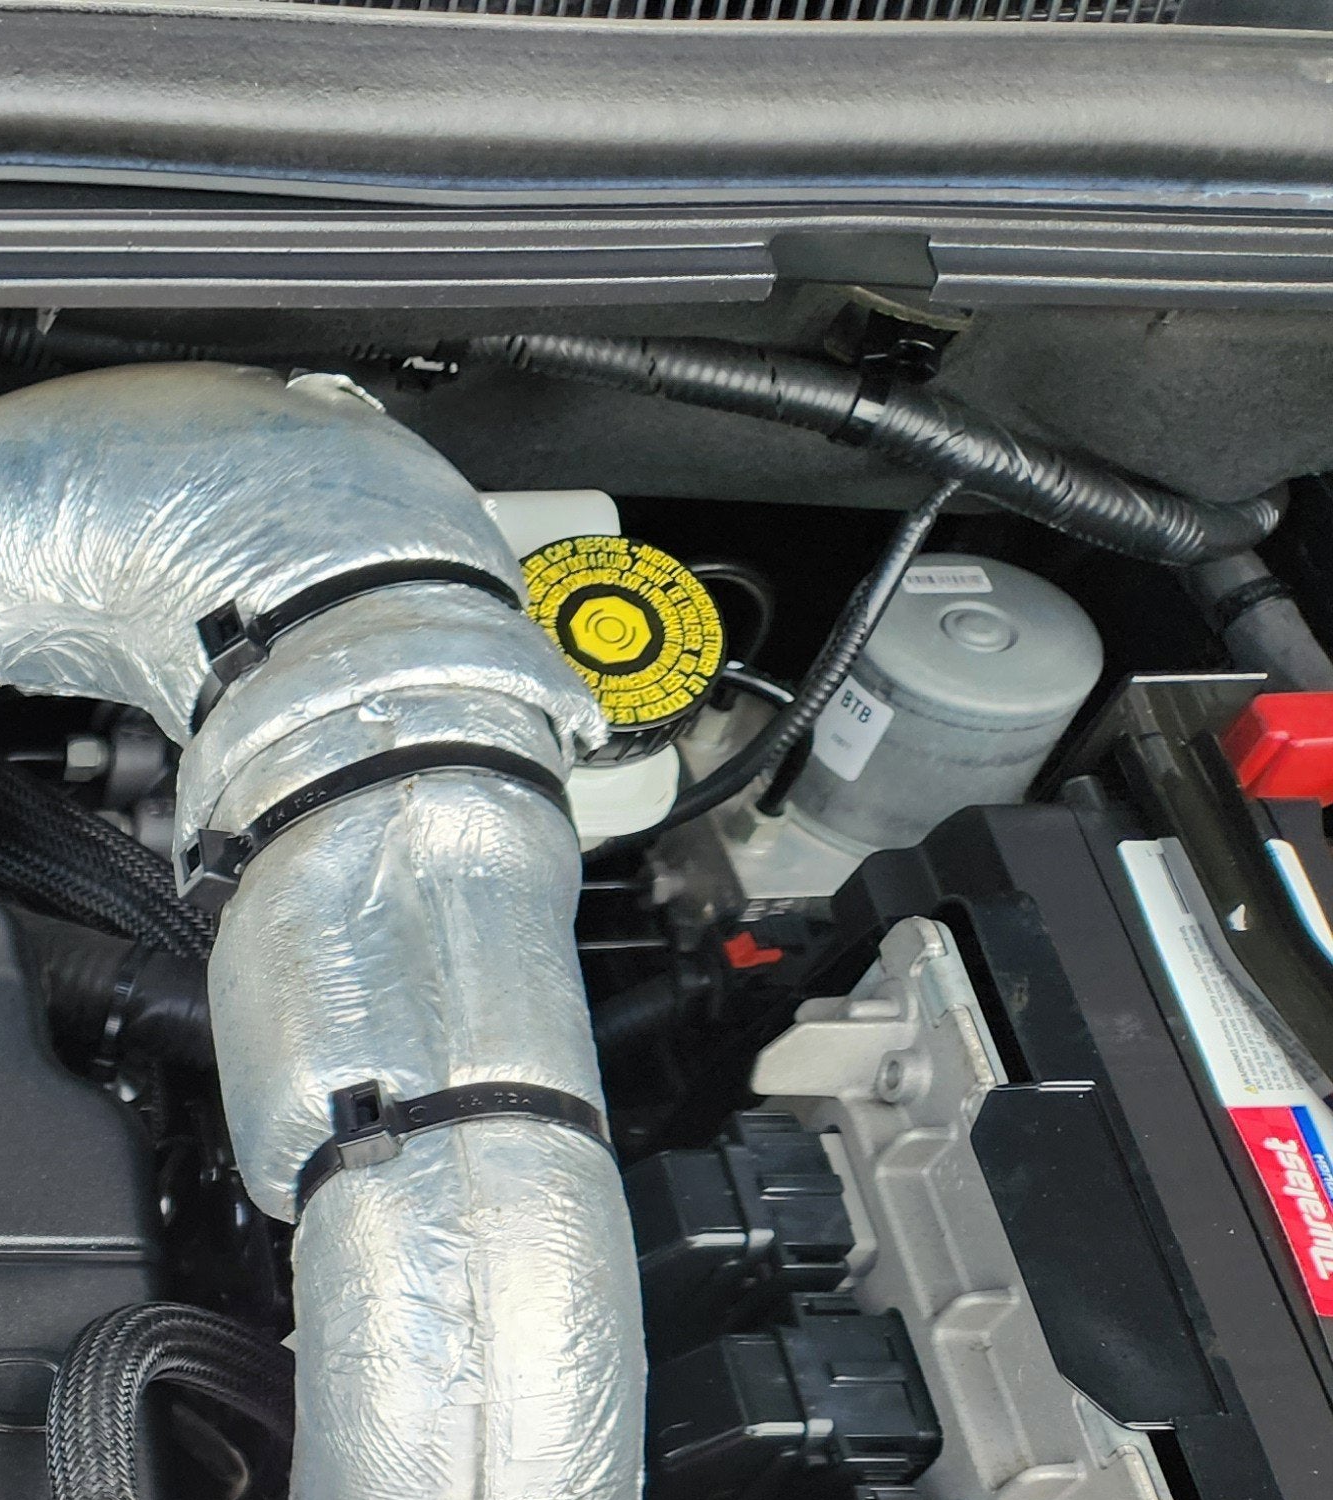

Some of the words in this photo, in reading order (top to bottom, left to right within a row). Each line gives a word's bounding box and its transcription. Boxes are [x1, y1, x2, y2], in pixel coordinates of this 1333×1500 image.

[543, 541, 573, 561] CAP
[574, 537, 629, 555] BEFORE
[597, 552, 632, 570] FLUID
[632, 560, 673, 587] AVANT
[841, 689, 872, 724] BTB
